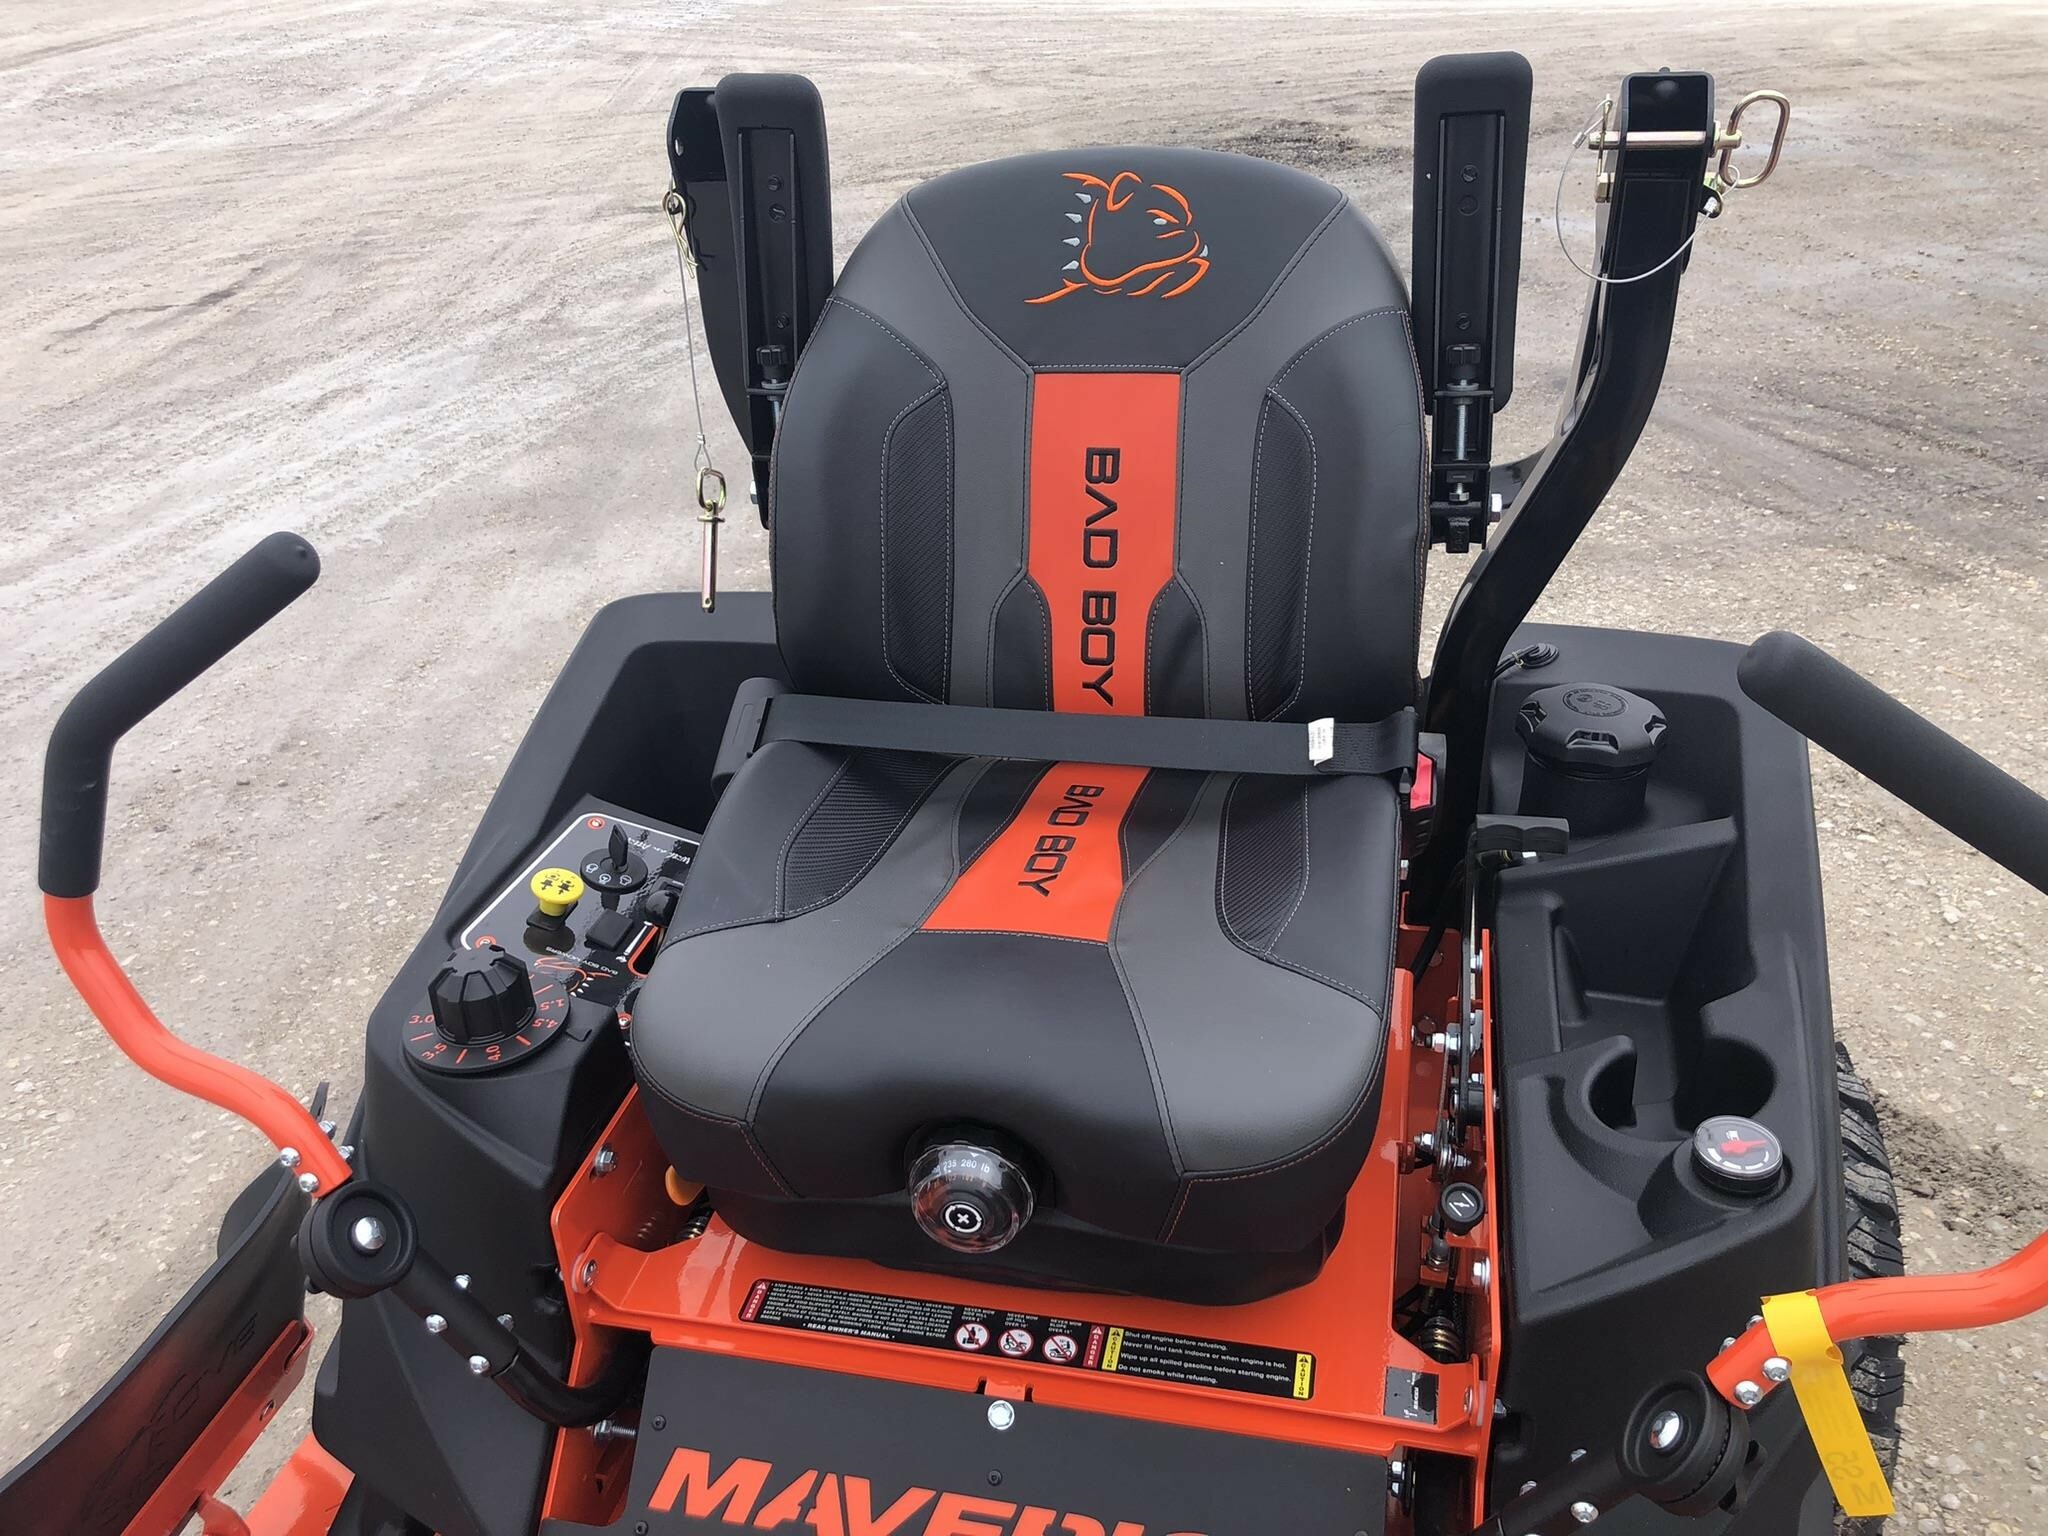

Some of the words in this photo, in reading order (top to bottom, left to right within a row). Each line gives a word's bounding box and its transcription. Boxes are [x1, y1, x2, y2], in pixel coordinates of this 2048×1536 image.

[1083, 447, 1120, 568] BAD
[1080, 590, 1117, 707] BOY
[1047, 784, 1105, 827] BAD
[1017, 835, 1076, 897] BOY
[545, 946, 581, 962] MOWERS
[583, 959, 600, 968] BOY
[600, 965, 619, 975] BAD
[408, 1014, 434, 1024] 3.0
[531, 1018, 558, 1029] 4.5
[421, 1042, 447, 1061] 3.5
[485, 1044, 502, 1061] 4.0
[960, 1158, 977, 1169] 280
[747, 1289, 762, 1319] DANGER
[827, 1326, 859, 1334] OWNER'S
[860, 1331, 891, 1339] MANUAL
[1087, 1334, 1100, 1366] DANGER
[1106, 1336, 1118, 1369] CAUTION
[1152, 1336, 1173, 1344] engine
[1197, 1342, 1228, 1352] refueling.
[1121, 1353, 1138, 1361] Wipe
[1160, 1358, 1182, 1367] spilled
[1184, 1362, 1212, 1371] gasoline
[1238, 1369, 1264, 1379] starting
[1266, 1373, 1292, 1382] engine.
[1241, 1358, 1264, 1367] engine
[1186, 1374, 1218, 1384] refueling.
[1297, 1363, 1308, 1396] CAUTION
